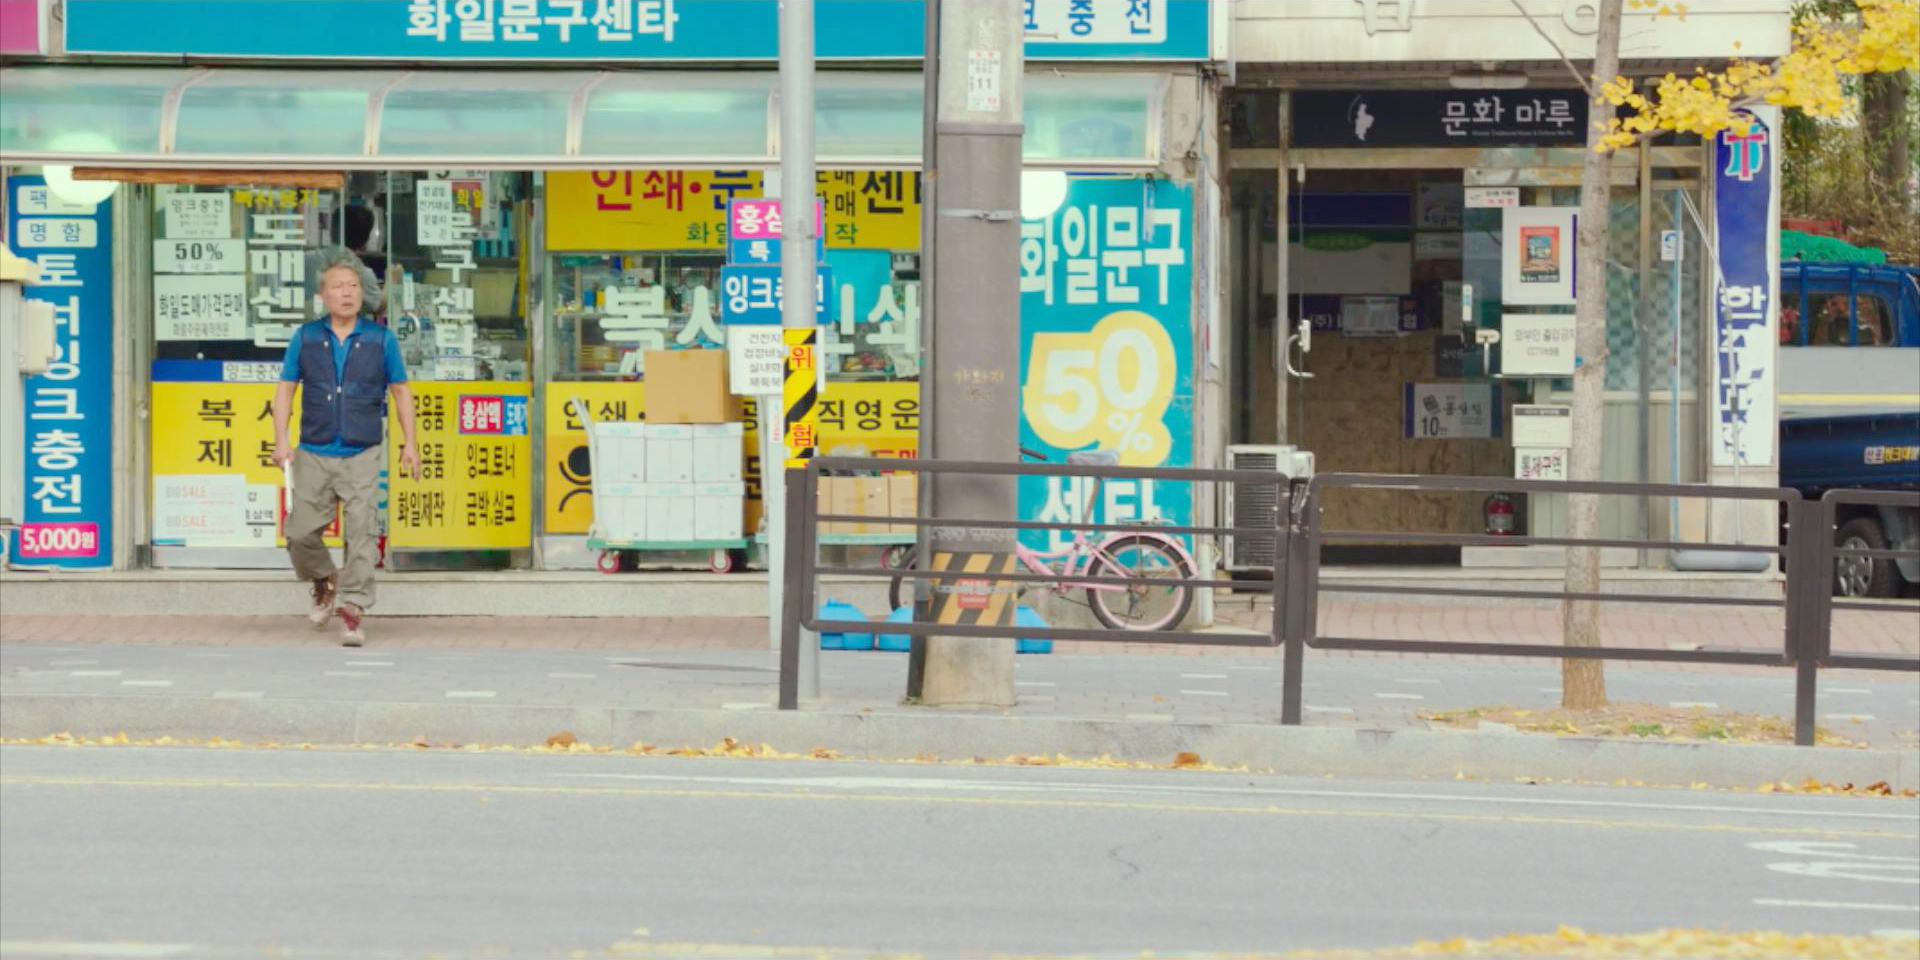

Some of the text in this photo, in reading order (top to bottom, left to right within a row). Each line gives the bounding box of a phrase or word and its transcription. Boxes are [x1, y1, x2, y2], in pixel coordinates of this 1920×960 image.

[405, 0, 680, 42] 화일문구센타
[1441, 95, 1575, 136] 문화 마루
[861, 171, 922, 214] 센
[174, 243, 224, 261] 50%
[1020, 204, 1186, 306] 화일문구
[159, 292, 244, 319] 화일도매가격판매
[1041, 327, 1159, 454] 50%
[461, 399, 501, 430] 홍삼액
[1421, 416, 1439, 436] 10
[397, 491, 445, 528] 화일제작
[22, 528, 95, 553] 5,000원
